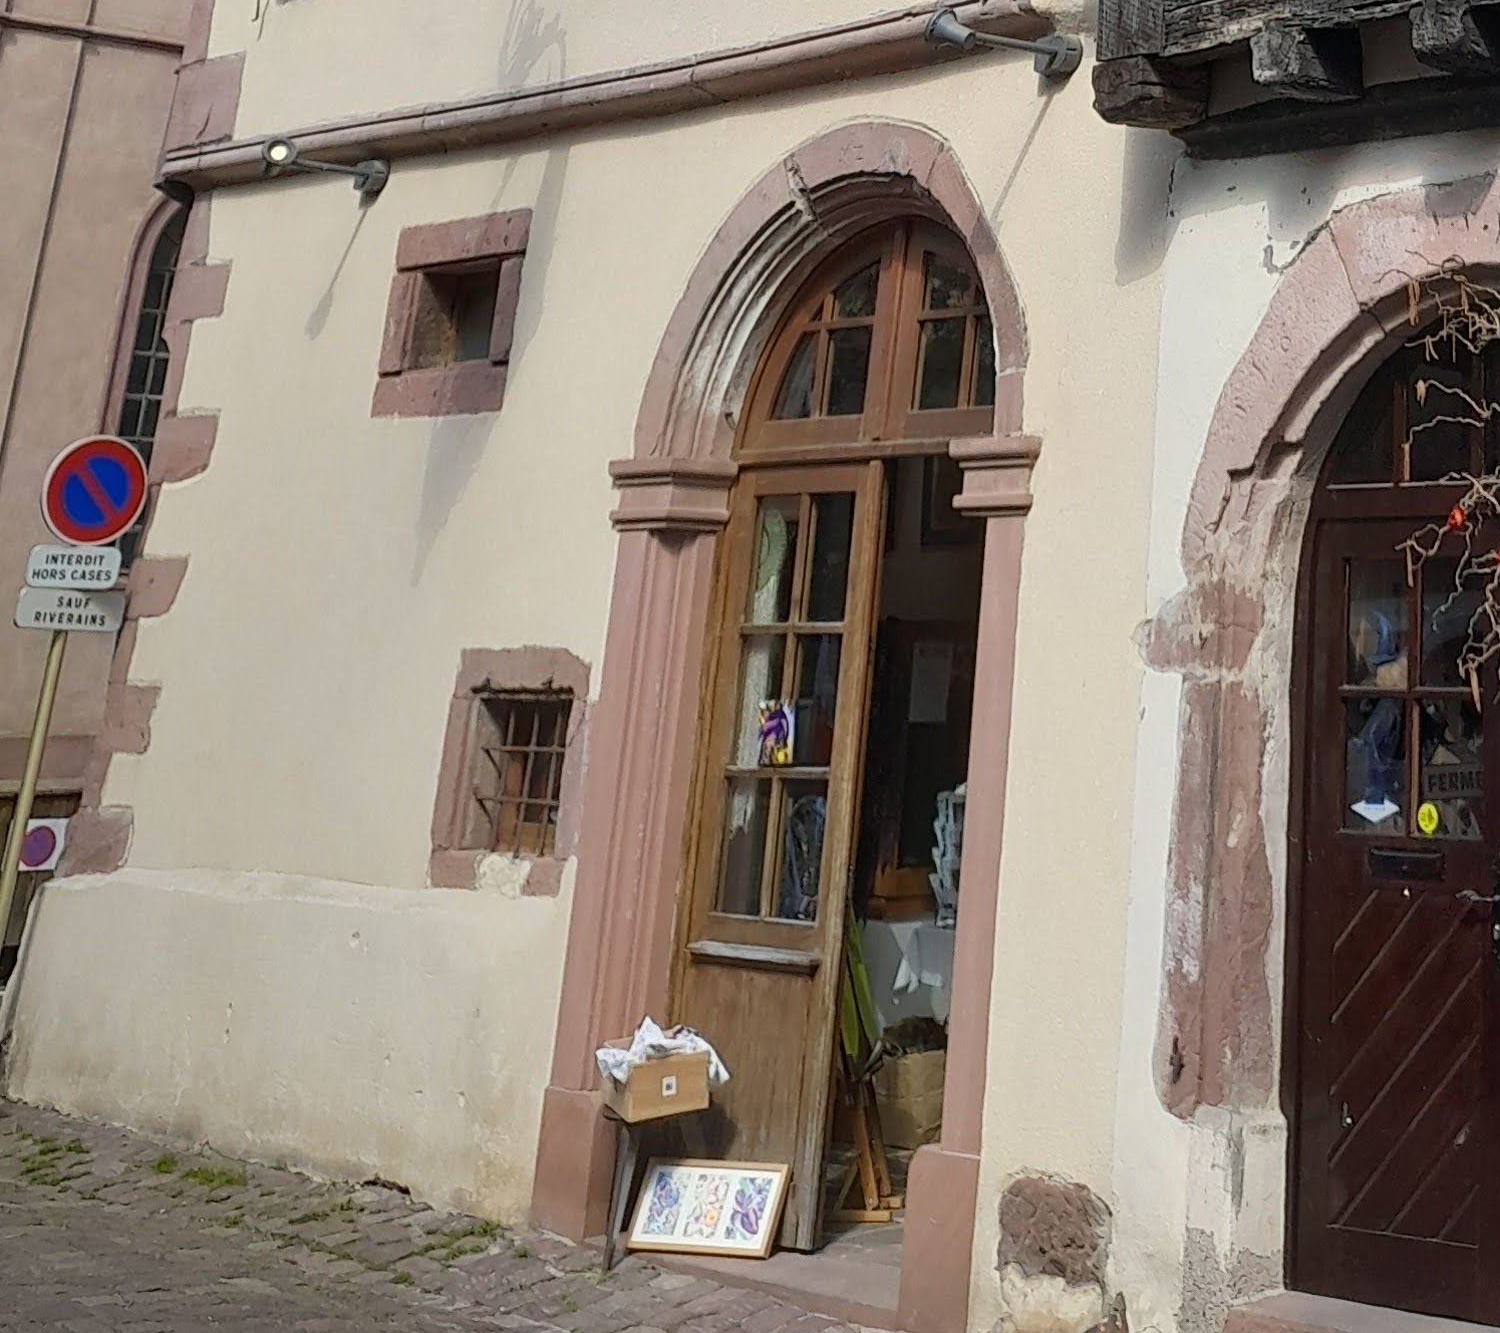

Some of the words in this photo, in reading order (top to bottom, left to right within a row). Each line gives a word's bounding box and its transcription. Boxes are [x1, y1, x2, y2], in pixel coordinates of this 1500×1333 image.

[45, 553, 105, 566] INTERDIT
[31, 568, 66, 581] HORS
[70, 569, 112, 582] CASES
[56, 596, 92, 609] SAUF
[33, 611, 106, 627] RIVERAINS
